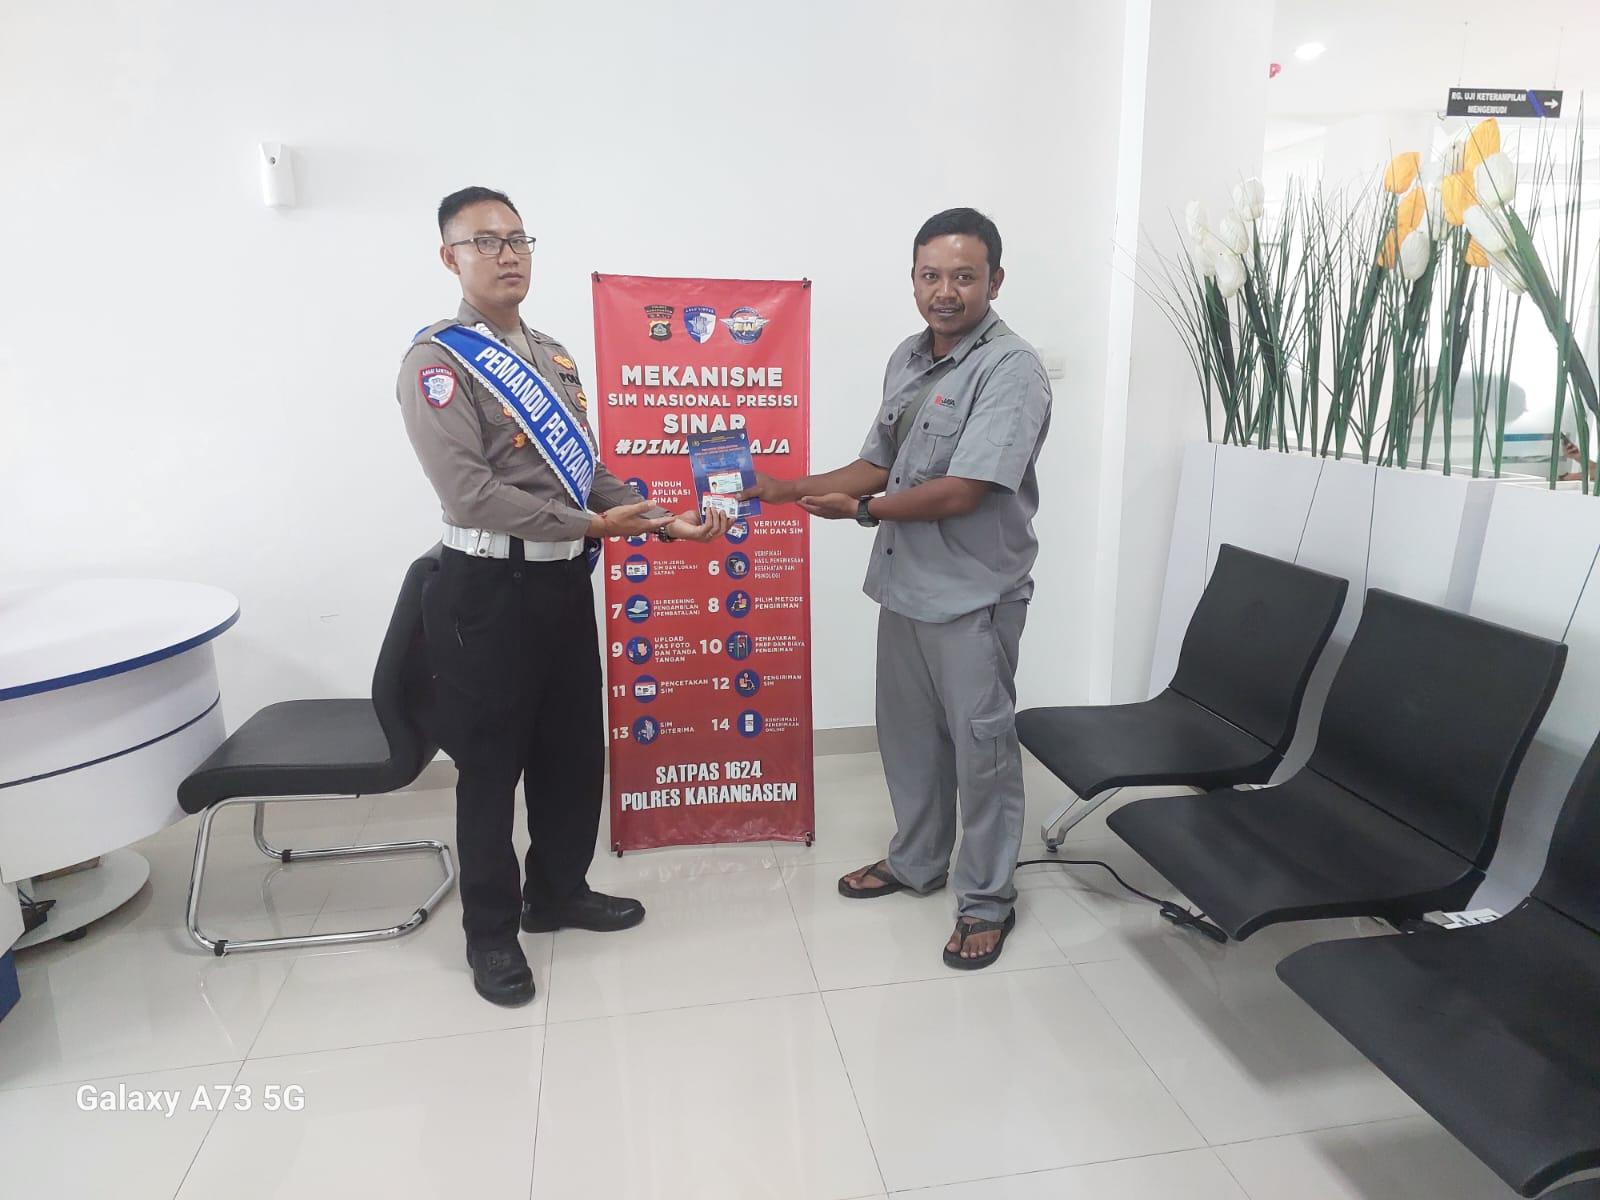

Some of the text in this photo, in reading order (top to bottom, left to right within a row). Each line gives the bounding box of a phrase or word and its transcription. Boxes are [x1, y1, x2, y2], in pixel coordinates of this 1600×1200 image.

[1464, 92, 1476, 100] UJI
[1476, 92, 1527, 102] KETERAMPILAN
[1467, 105, 1508, 114] MENGEMUDI
[474, 346, 552, 422] PEMANDU
[621, 365, 783, 387] MEKANISME
[608, 393, 798, 407] SIM NASIONAL PRESISI
[664, 414, 746, 434] SINAR
[750, 439, 790, 454] AJA
[610, 564, 622, 580] 5
[708, 560, 720, 576] 6
[612, 604, 622, 620] 7
[708, 597, 720, 613] 8
[612, 641, 623, 658] 9
[699, 638, 723, 654] 10
[612, 685, 626, 697] 11
[660, 679, 708, 687] PENCETAKAN
[712, 677, 730, 690] 12
[712, 718, 730, 731] 14
[612, 726, 629, 740] 13
[656, 760, 762, 785] SATPAS 1624
[621, 783, 797, 811] POLRES KARANGASEM
